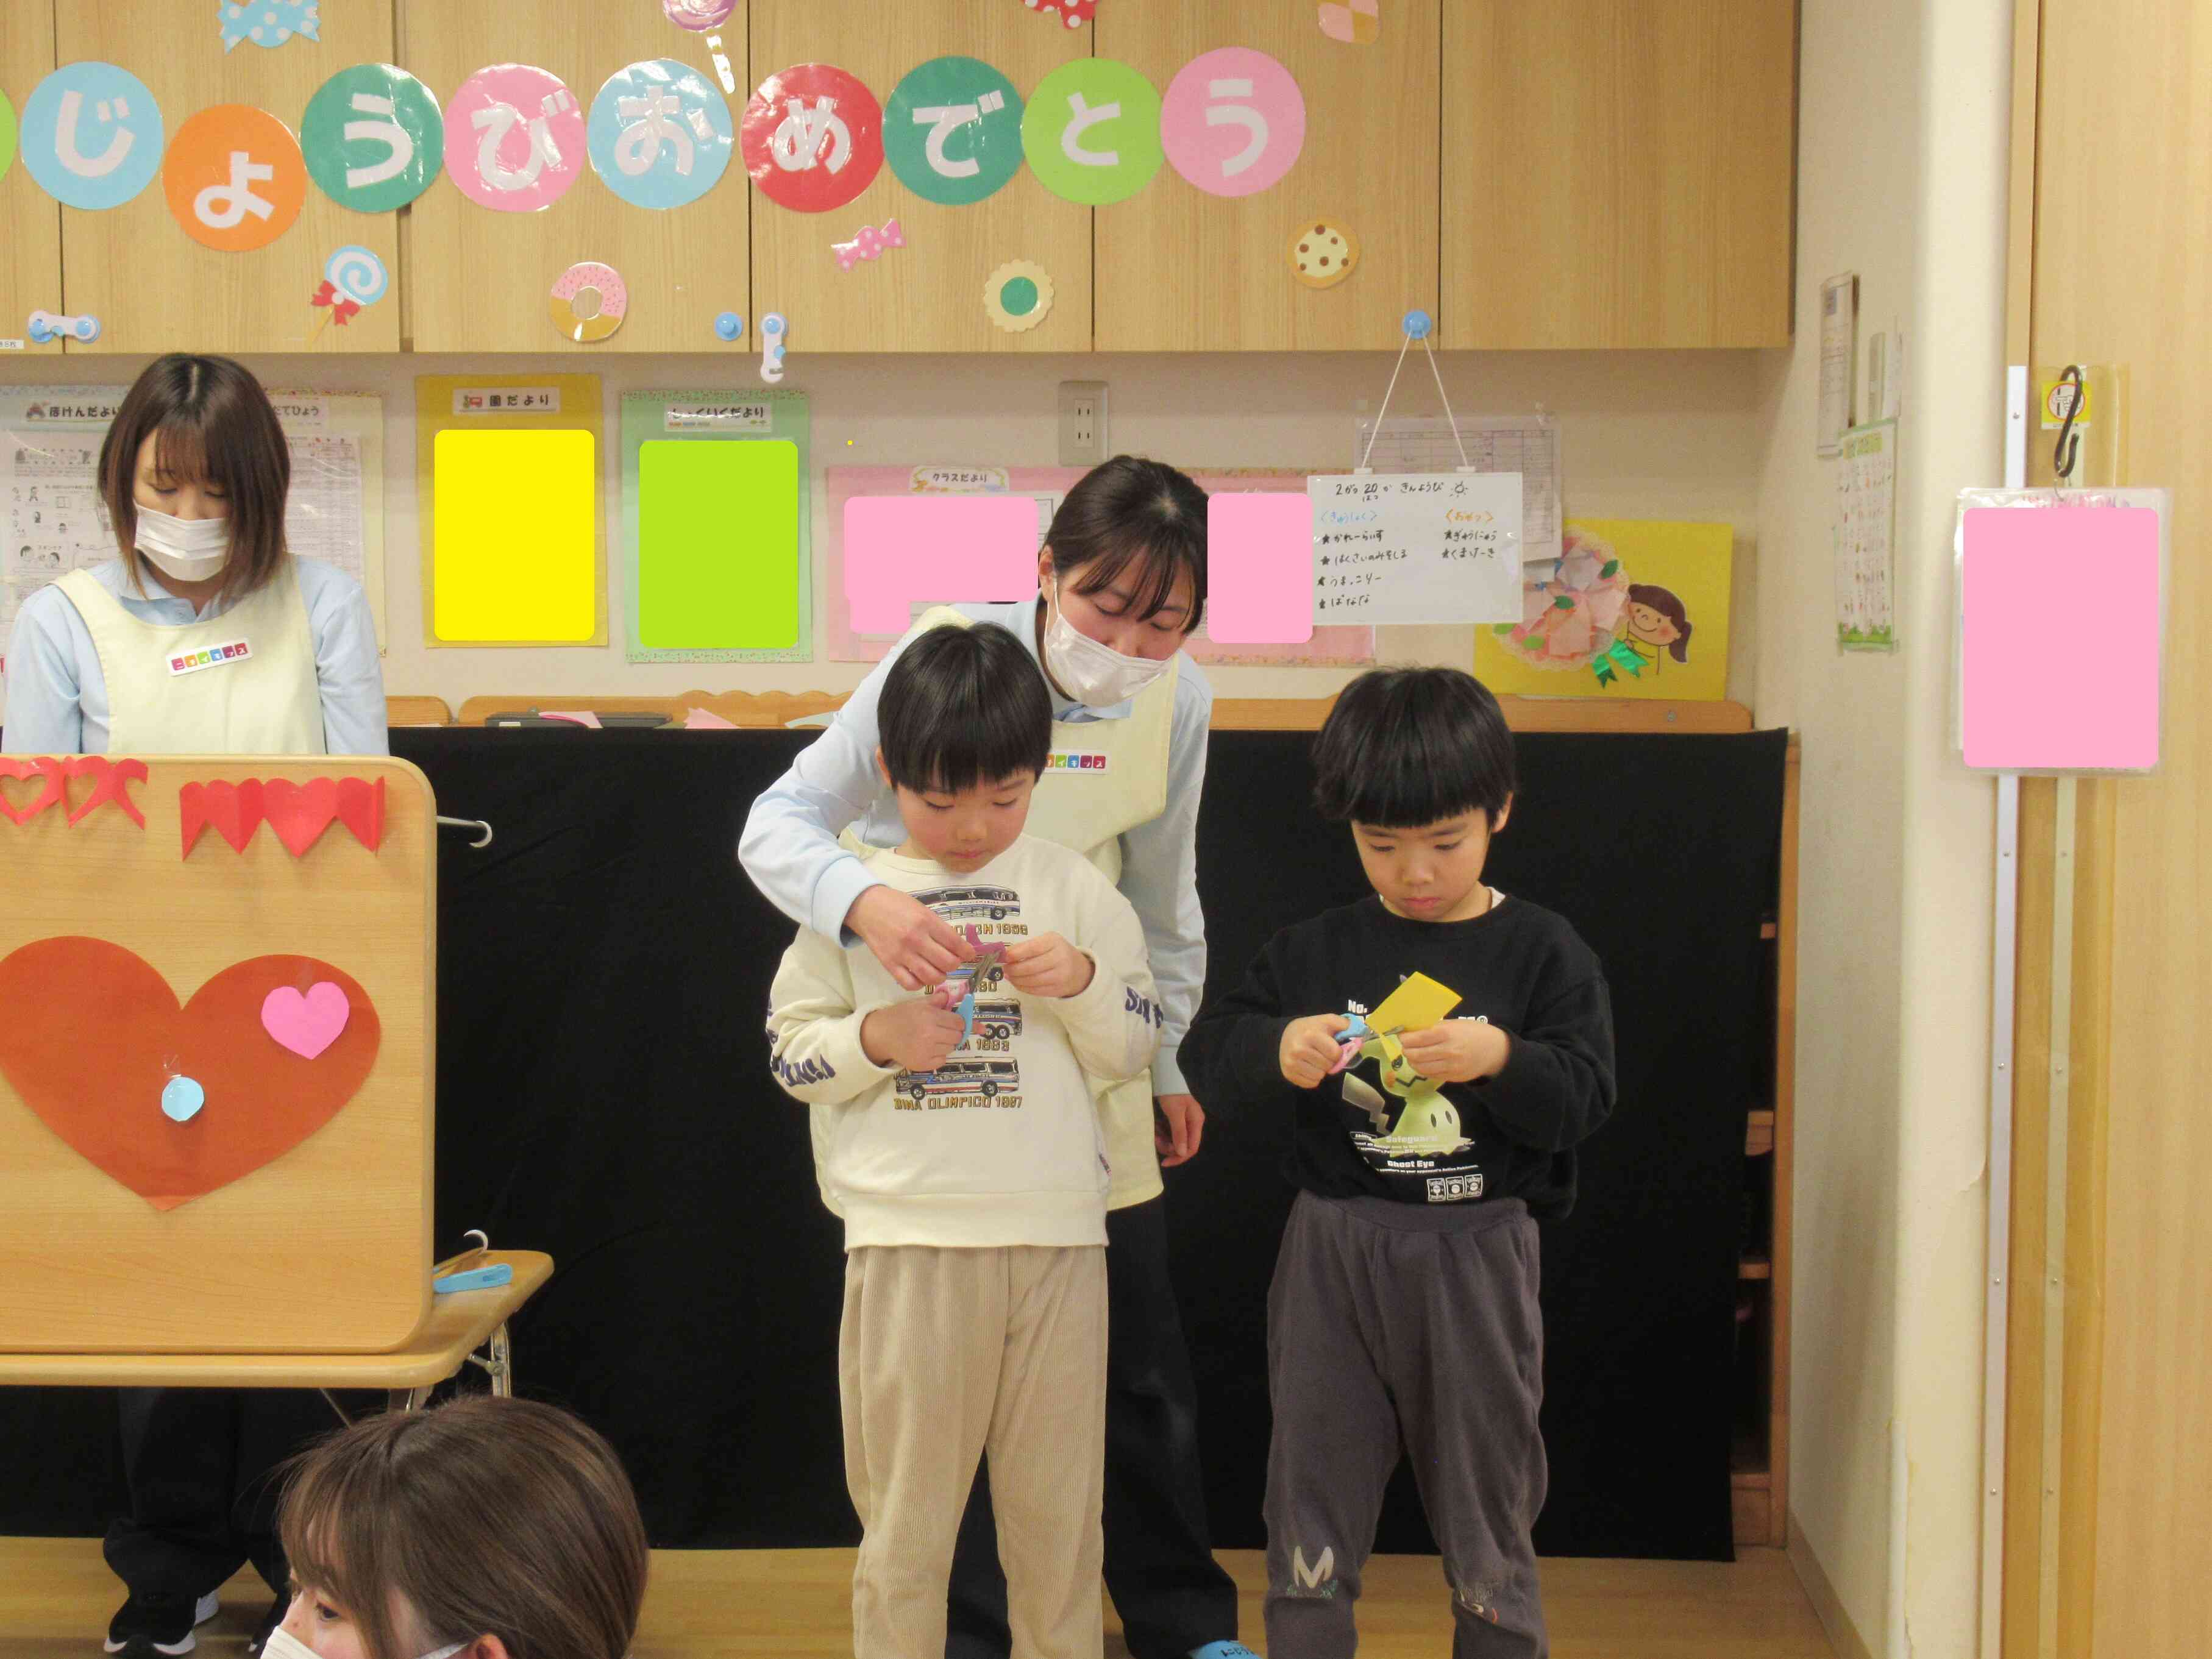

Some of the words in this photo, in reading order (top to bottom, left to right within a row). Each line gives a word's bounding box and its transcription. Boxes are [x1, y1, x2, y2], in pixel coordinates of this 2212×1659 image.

[489, 394, 549, 407] 園だより
[933, 472, 987, 483] クラスだより
